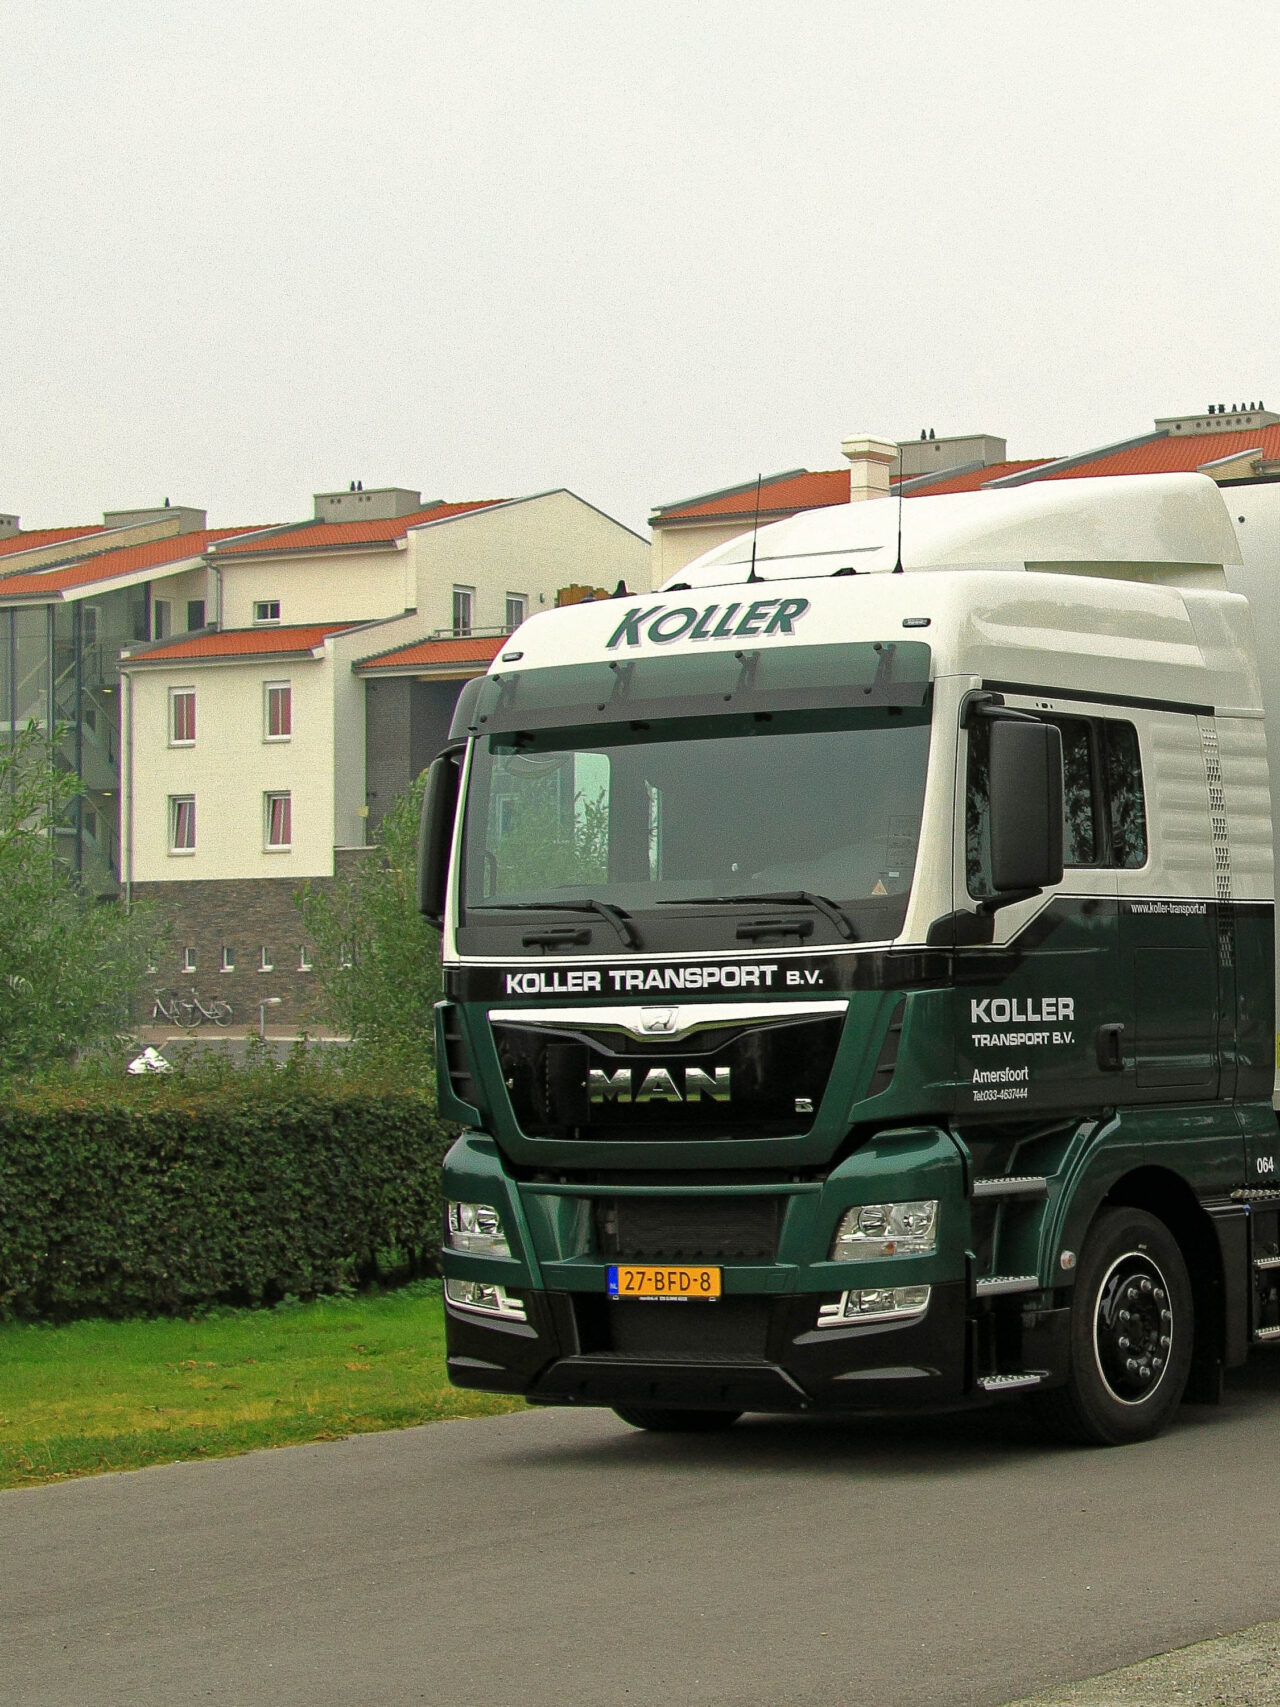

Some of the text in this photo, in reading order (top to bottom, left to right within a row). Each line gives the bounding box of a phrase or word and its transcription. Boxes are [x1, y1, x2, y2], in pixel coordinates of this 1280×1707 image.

[605, 598, 811, 650] KOLLER
[1130, 902, 1207, 917] www.koller-transport.nl
[506, 965, 824, 994] KOLLER TRANSPORT B.V.
[970, 997, 1075, 1023] KOLLER
[971, 1031, 1075, 1047] TRANSPORT B.V.
[589, 1067, 731, 1102] MAN
[972, 1066, 1029, 1083] Amersfoort
[1256, 1156, 1274, 1174] 064
[624, 1271, 711, 1291] 27-BFD-8
